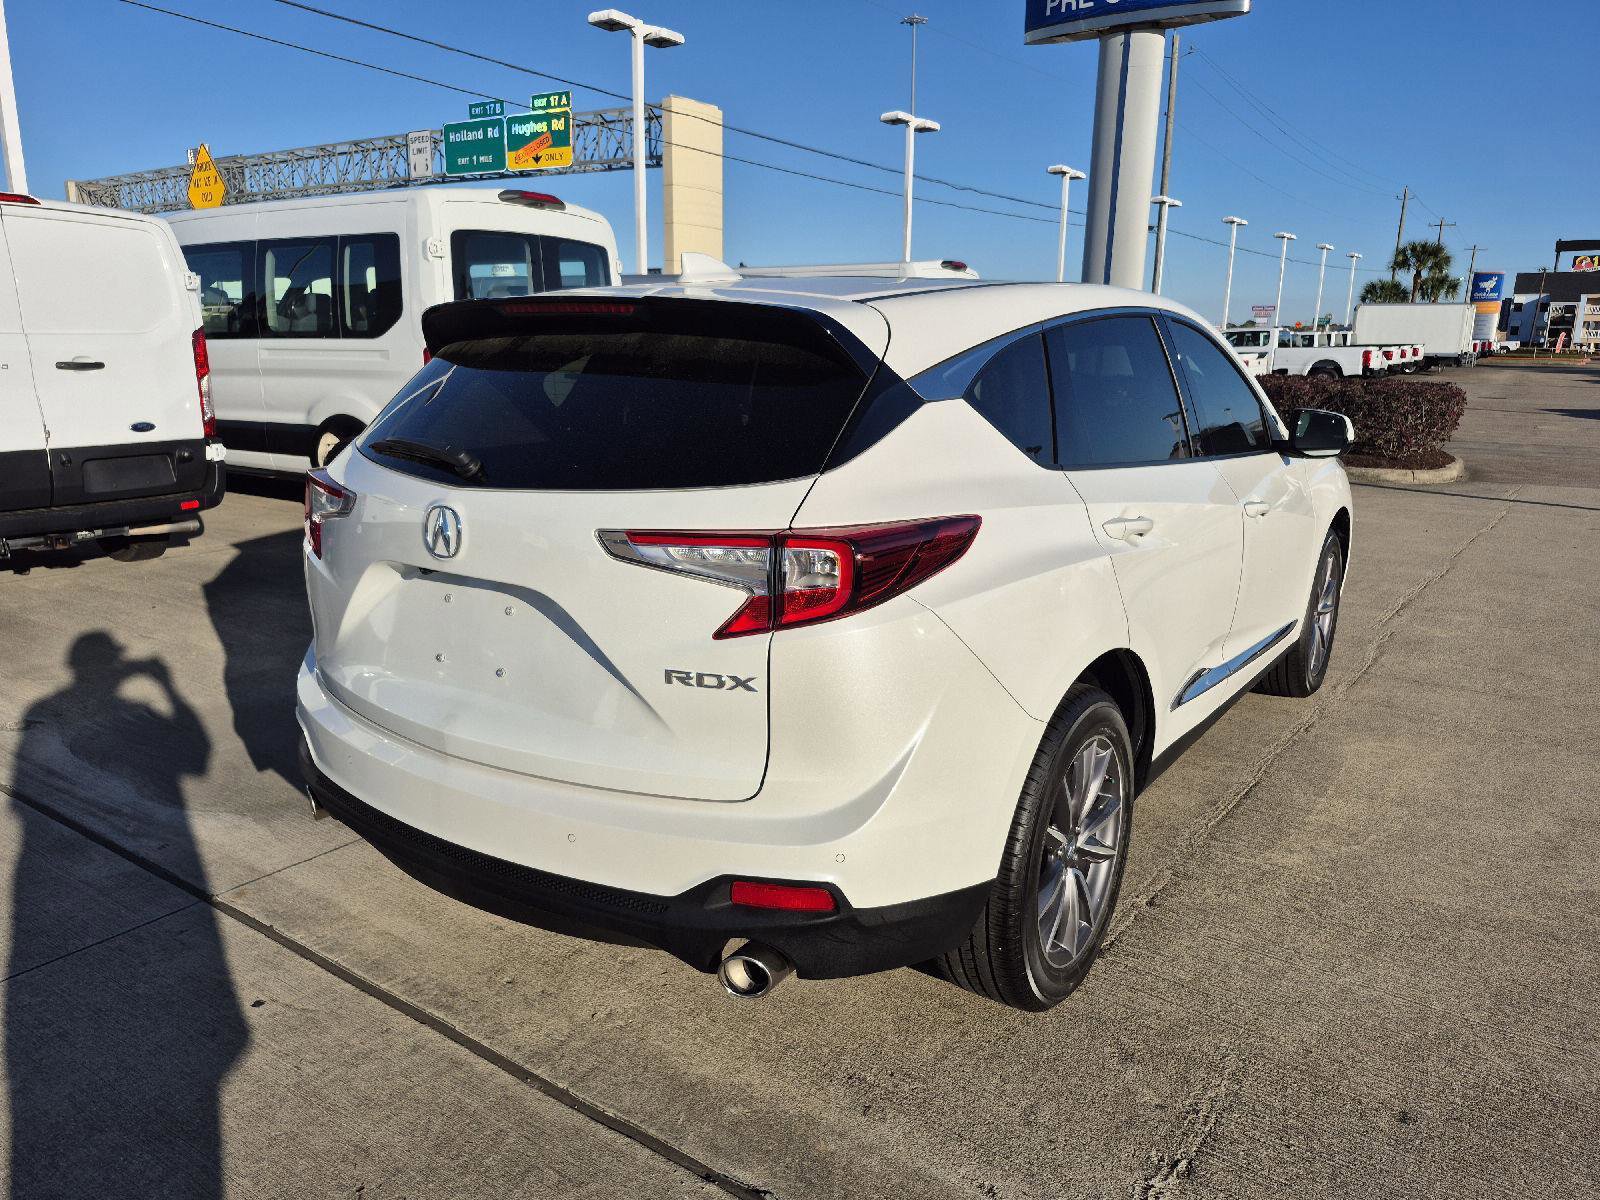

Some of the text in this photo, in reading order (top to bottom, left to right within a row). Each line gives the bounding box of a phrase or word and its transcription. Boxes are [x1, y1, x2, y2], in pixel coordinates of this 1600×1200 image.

[472, 106, 483, 115] EXIT
[511, 118, 565, 137] Hughes Rd
[449, 126, 500, 142] Holland Rd
[410, 135, 429, 144] SPEED
[457, 155, 493, 165] EXIT 1 MILE
[545, 152, 564, 162] ONLY
[665, 669, 758, 692] RDX
